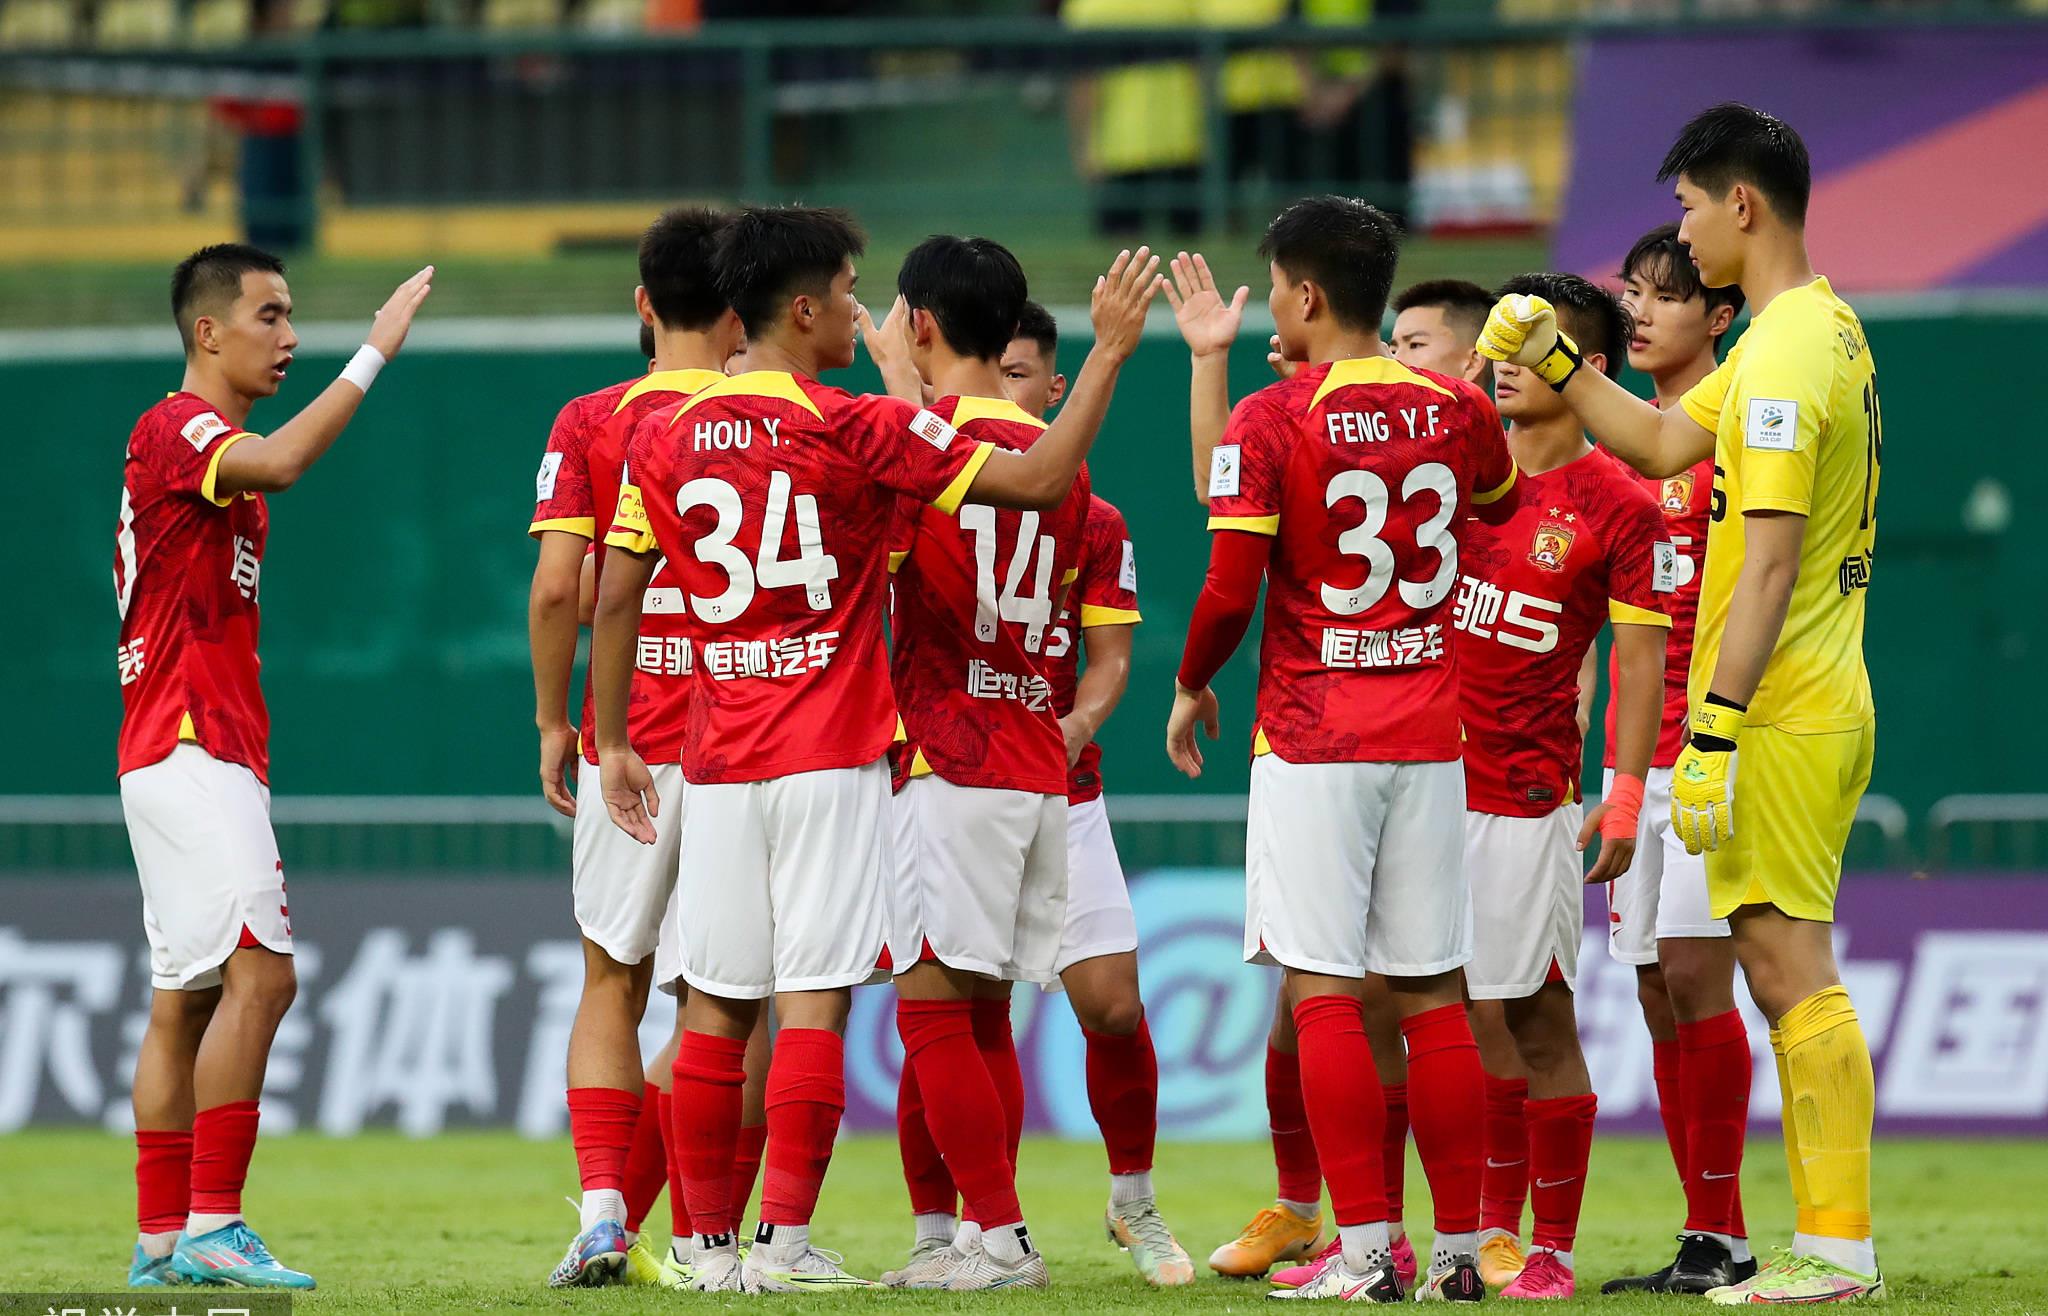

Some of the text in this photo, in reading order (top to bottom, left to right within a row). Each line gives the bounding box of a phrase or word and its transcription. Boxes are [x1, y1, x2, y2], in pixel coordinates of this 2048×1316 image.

[693, 418, 791, 452] HOU Y.
[1325, 405, 1450, 444] FENG Y.F.
[231, 534, 260, 603] 恒
[676, 470, 839, 624] 34
[1321, 462, 1458, 616] 33
[959, 503, 1056, 653] 14
[1320, 623, 1445, 669] 恒驰汽车
[1452, 574, 1563, 654] 驰5
[703, 630, 840, 681] 恒驰汽车
